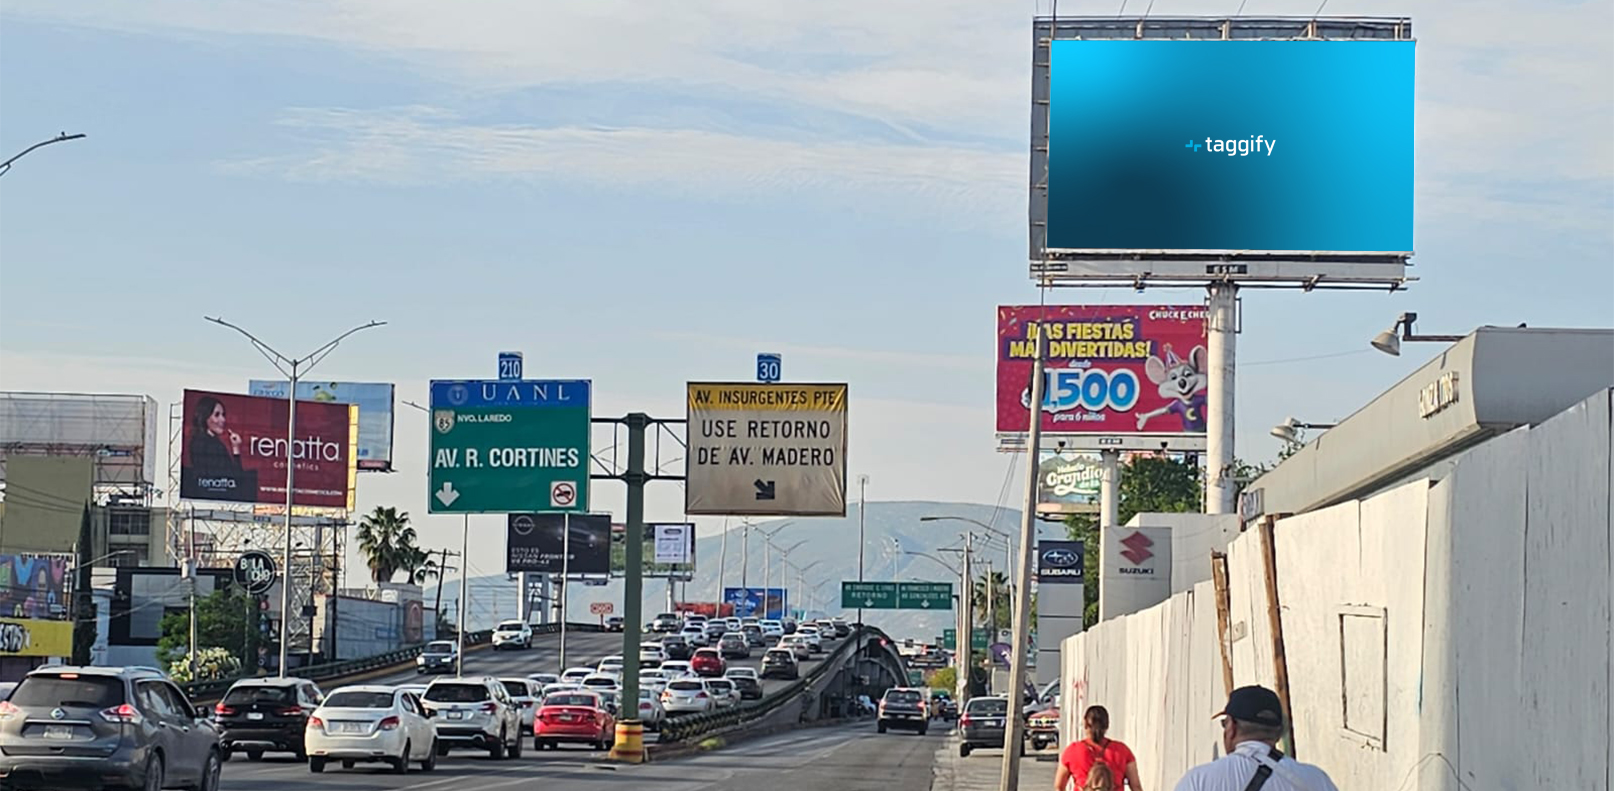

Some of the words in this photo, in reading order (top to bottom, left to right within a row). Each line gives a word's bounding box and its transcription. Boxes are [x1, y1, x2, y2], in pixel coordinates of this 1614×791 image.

[1205, 135, 1276, 156] taggify
[1149, 310, 1179, 320] CHUCK
[1188, 310, 1211, 319] CHE
[1066, 322, 1134, 340] FIESTAS
[1049, 339, 1151, 358] DIVERTIDAS!
[500, 361, 521, 378] 210
[759, 362, 779, 379] 30
[482, 384, 571, 401] UANL
[695, 390, 714, 404] AV.
[718, 390, 808, 405] INSURGENTES
[813, 390, 836, 406] PTE
[1022, 368, 1140, 413] 1,500
[438, 418, 451, 430] 85
[478, 414, 513, 423] LAREDO
[1053, 412, 1074, 423] para
[1075, 411, 1082, 421] 6
[701, 419, 737, 438] USE
[748, 420, 832, 439] RETORNO
[250, 435, 340, 461] renatta
[697, 447, 720, 465] DE
[728, 447, 754, 465] AV.
[762, 447, 834, 466] MADERO
[273, 461, 319, 471] coetics
[434, 448, 460, 468] AV.
[465, 448, 484, 468] R.
[489, 448, 579, 468] CORTINES
[1040, 568, 1081, 576] SUBARU
[1119, 567, 1154, 575] SUZUKI
